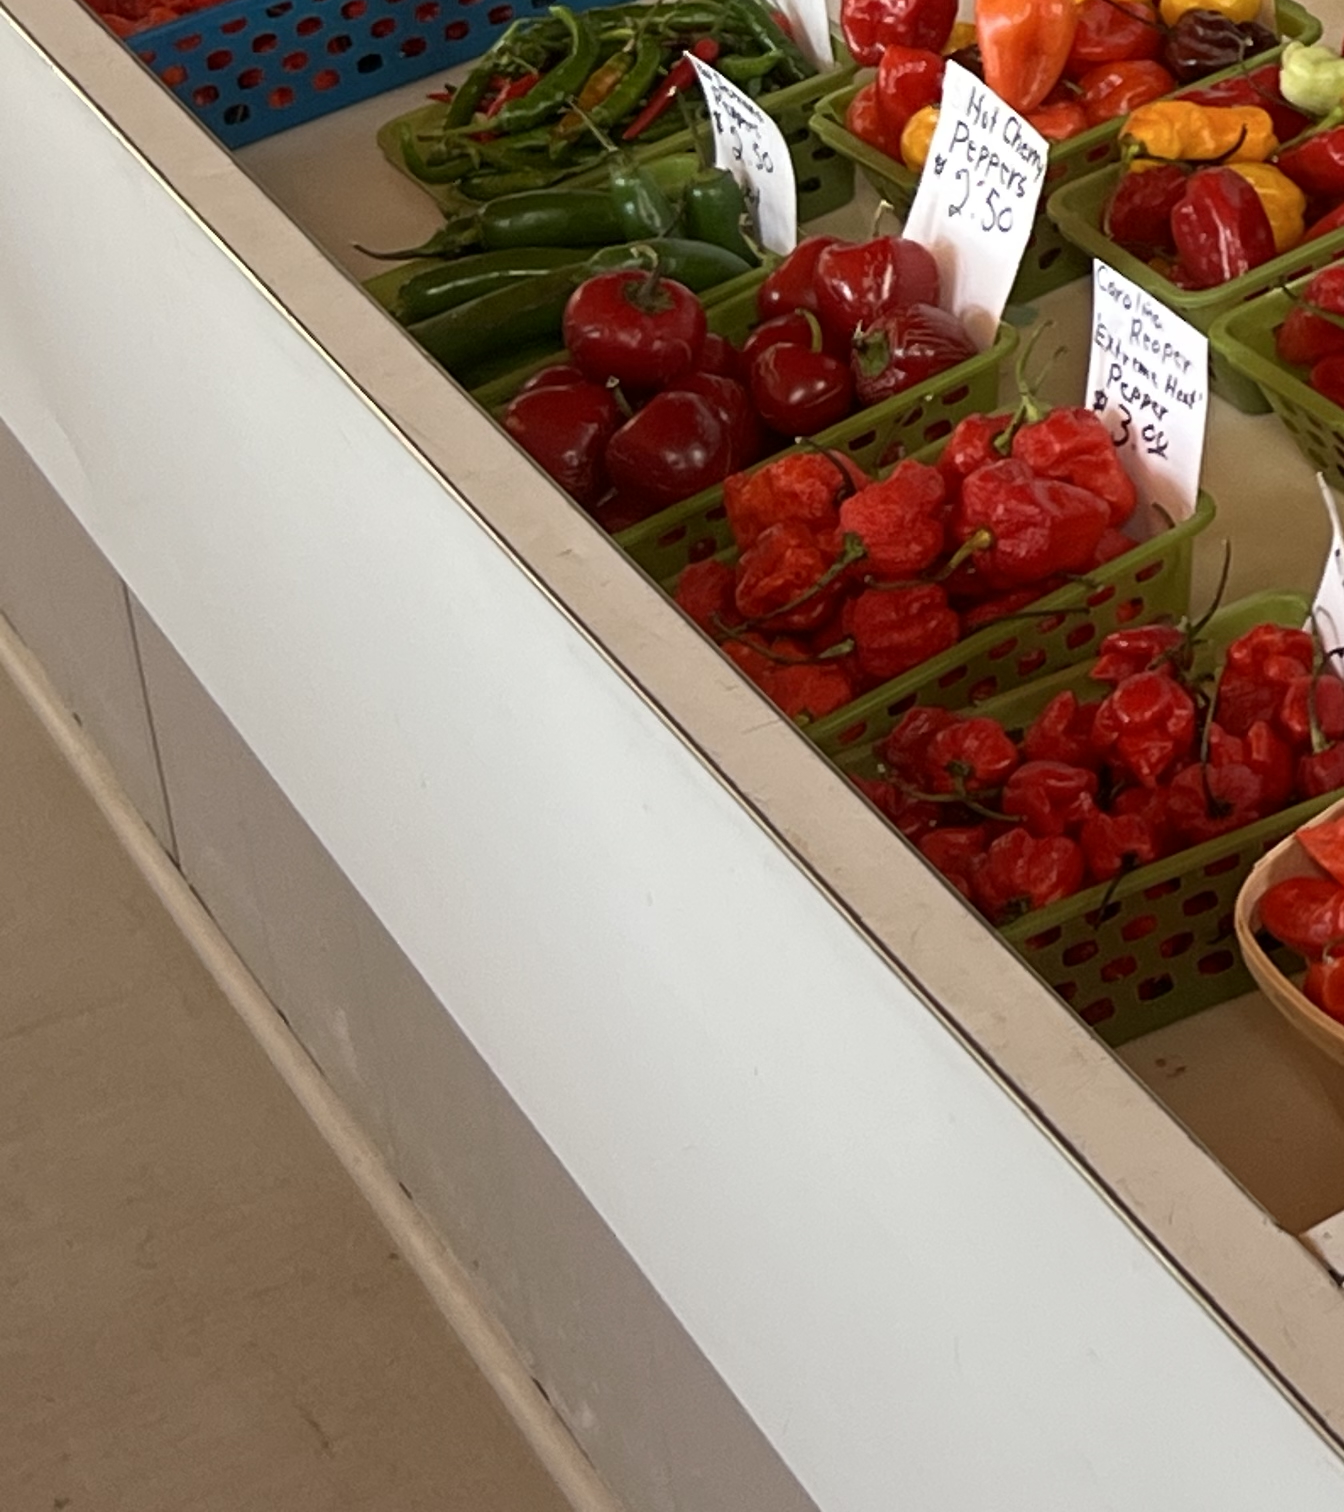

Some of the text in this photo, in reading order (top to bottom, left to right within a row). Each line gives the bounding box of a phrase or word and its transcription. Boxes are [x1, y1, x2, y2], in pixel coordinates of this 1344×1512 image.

[949, 120, 1029, 199] Peppers
[966, 86, 1045, 182] Hot Cherry
[1129, 317, 1193, 377] Reaper
[1107, 362, 1169, 421] Pepper
